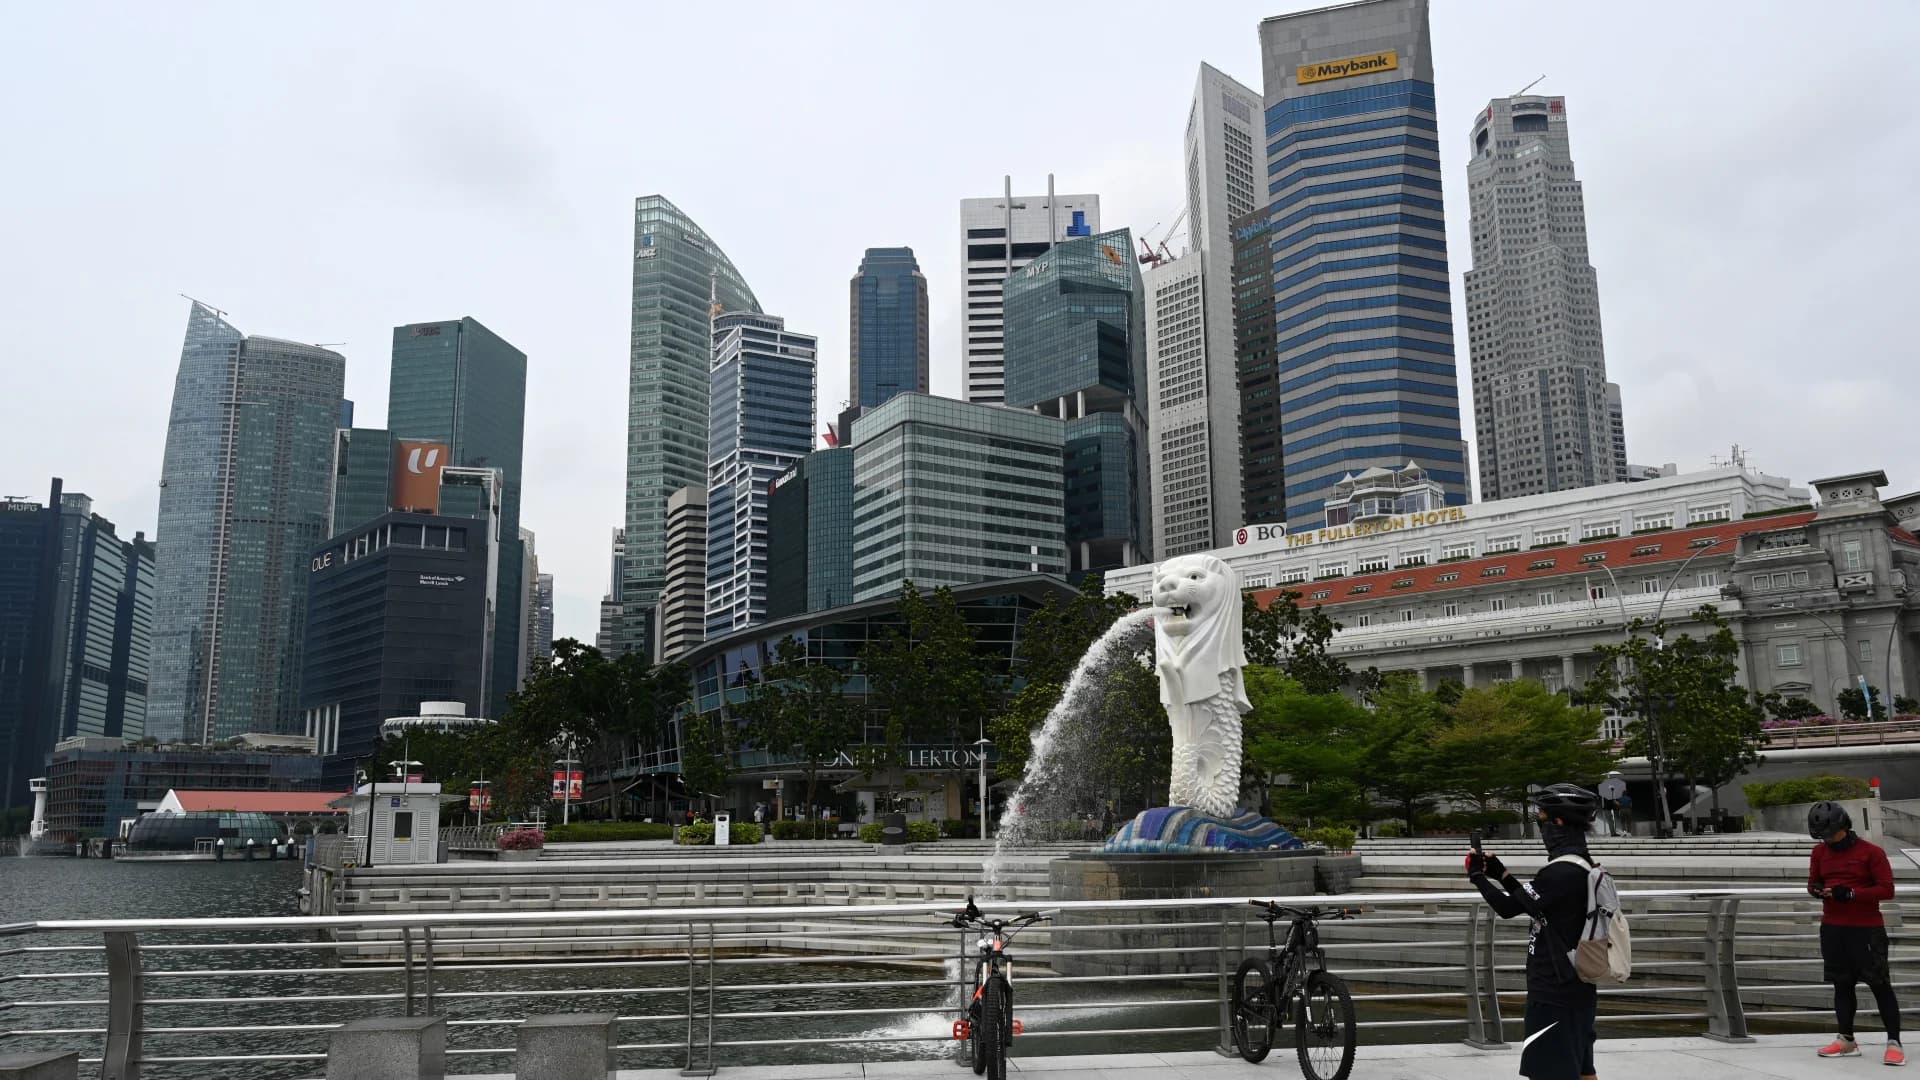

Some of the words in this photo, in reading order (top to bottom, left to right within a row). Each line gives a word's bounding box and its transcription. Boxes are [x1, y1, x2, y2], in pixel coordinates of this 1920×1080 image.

[1317, 56, 1388, 76] Maybank
[1026, 261, 1049, 278] MYP
[7, 503, 38, 512] MUFG
[1256, 524, 1287, 541] BO
[1285, 533, 1313, 548] THE
[1318, 516, 1405, 542] FULLERTON
[1411, 507, 1467, 528] HOTEL
